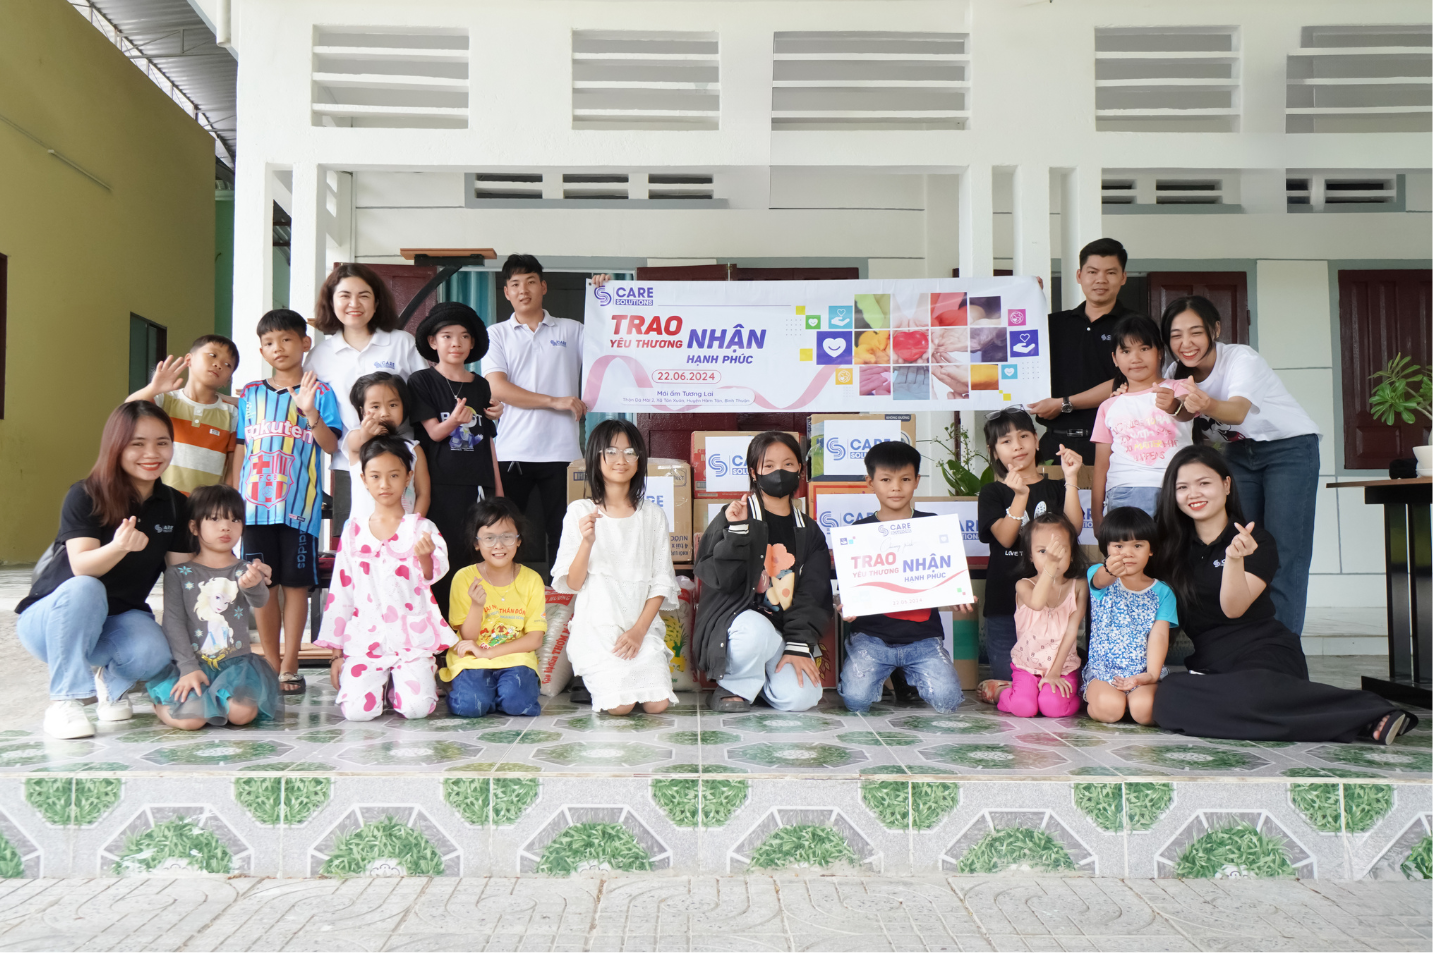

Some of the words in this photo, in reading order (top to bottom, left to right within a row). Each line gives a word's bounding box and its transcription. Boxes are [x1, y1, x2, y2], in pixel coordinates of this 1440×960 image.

[615, 287, 654, 298] CARE
[611, 315, 683, 336] TRAO
[610, 337, 632, 348] YÊU
[635, 339, 683, 349] THƯƠNG
[687, 323, 767, 353] NHẬN
[686, 355, 719, 366] HẠNH
[722, 353, 754, 364] PHÚC
[657, 372, 716, 381] 22.06.2024
[245, 419, 313, 444] Rakuten
[890, 522, 911, 531] CARE
[851, 552, 897, 569] TRAO
[902, 553, 951, 573] NHẬN
[852, 570, 867, 578] YÊU
[869, 567, 900, 577] THƯƠNG
